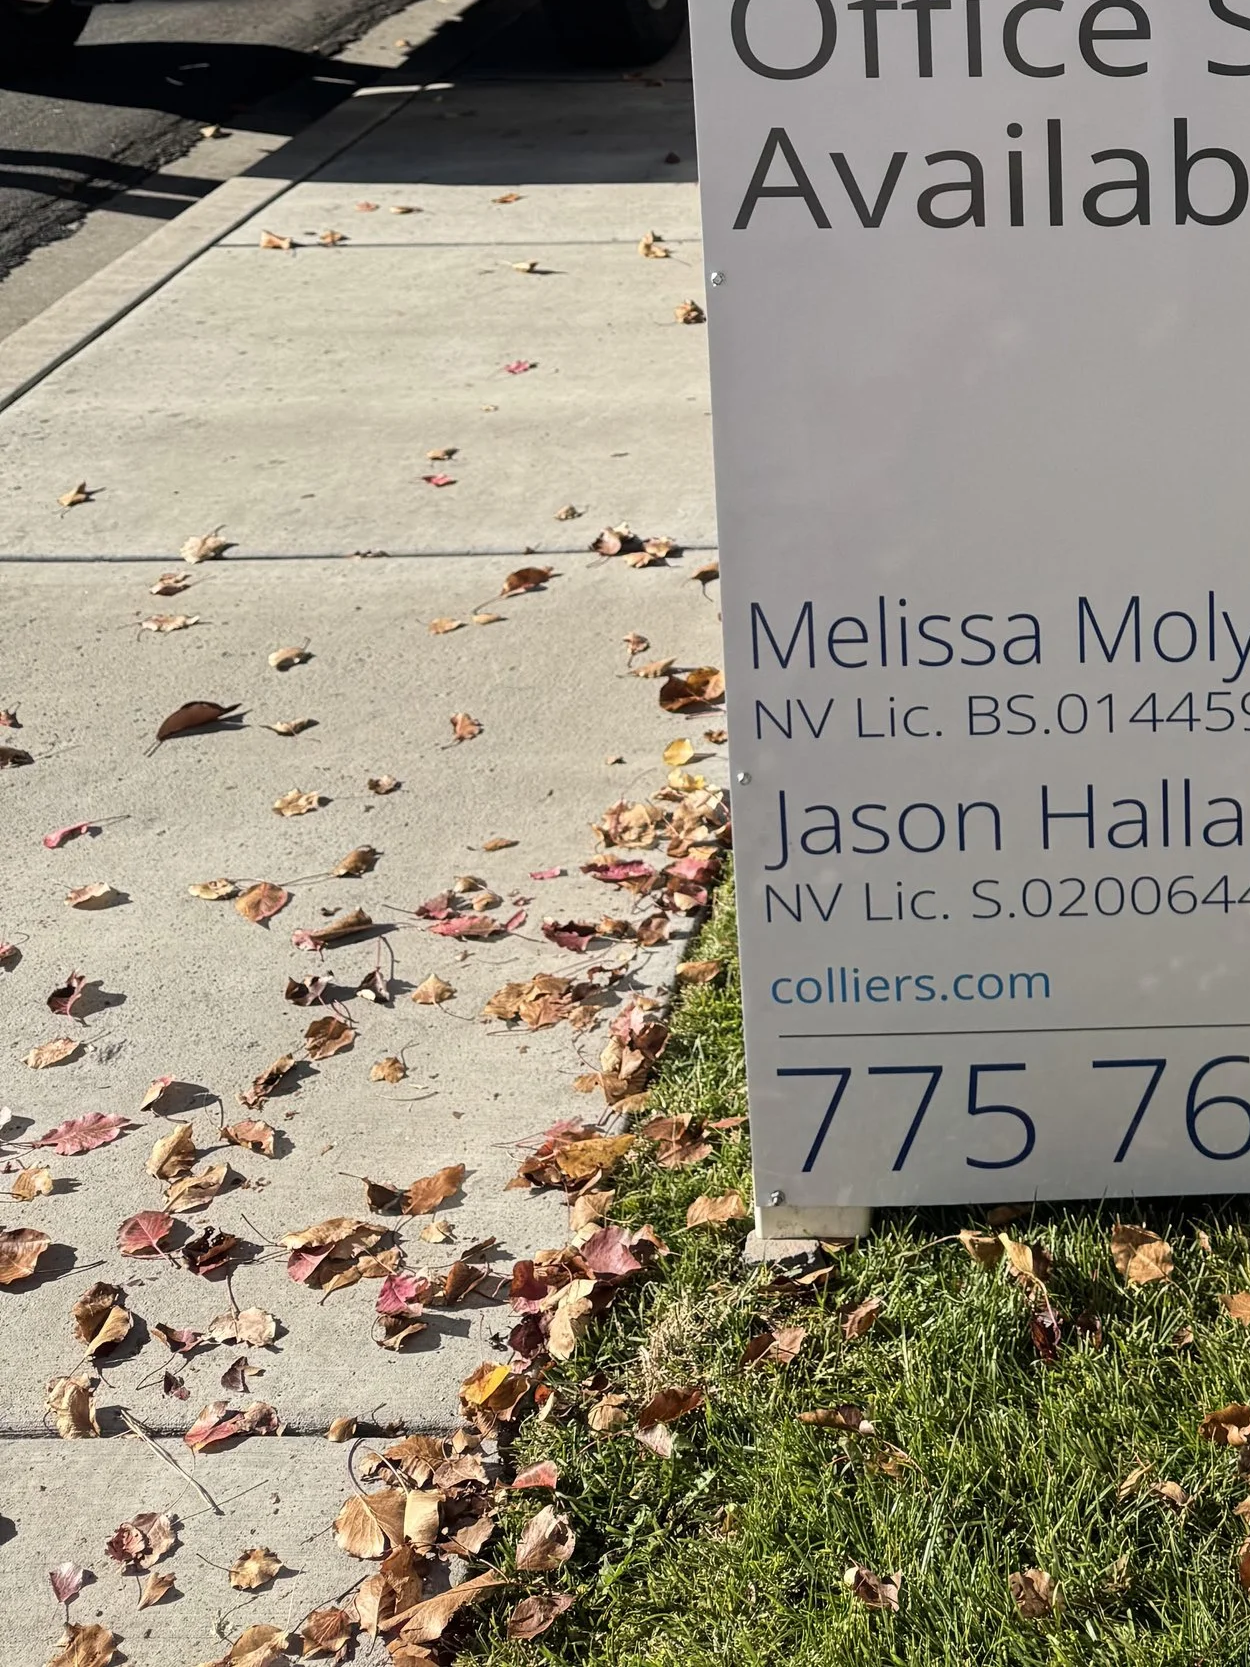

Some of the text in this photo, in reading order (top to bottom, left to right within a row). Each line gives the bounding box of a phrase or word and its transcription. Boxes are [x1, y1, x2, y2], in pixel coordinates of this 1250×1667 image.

[751, 596, 1041, 669] Melissa
[756, 698, 834, 739] NV
[857, 697, 942, 738] Lic.
[765, 790, 1001, 870] Jason
[766, 883, 842, 923] NV
[866, 881, 948, 921] Lic.
[772, 967, 1050, 1004] colliers.com
[777, 1063, 1035, 1172] 775
